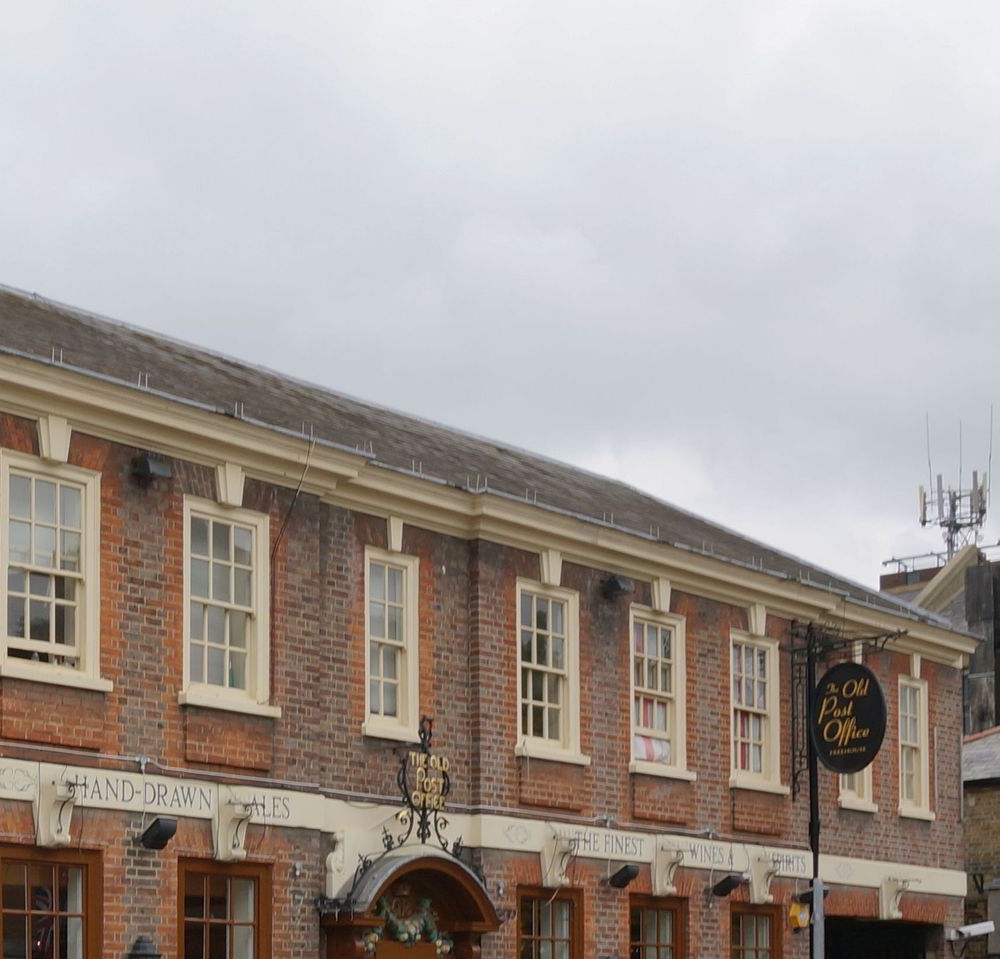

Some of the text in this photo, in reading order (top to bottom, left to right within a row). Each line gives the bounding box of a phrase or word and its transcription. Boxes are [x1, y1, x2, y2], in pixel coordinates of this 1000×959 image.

[842, 678, 870, 698] Old
[818, 695, 853, 725] Post
[823, 717, 870, 746] Office
[409, 751, 449, 772] THE OLD
[74, 774, 290, 820] HAND-DRAWN ALES
[574, 831, 645, 857] THE FINEST
[689, 843, 724, 865] WINES
[771, 852, 807, 875] SPIRITS
